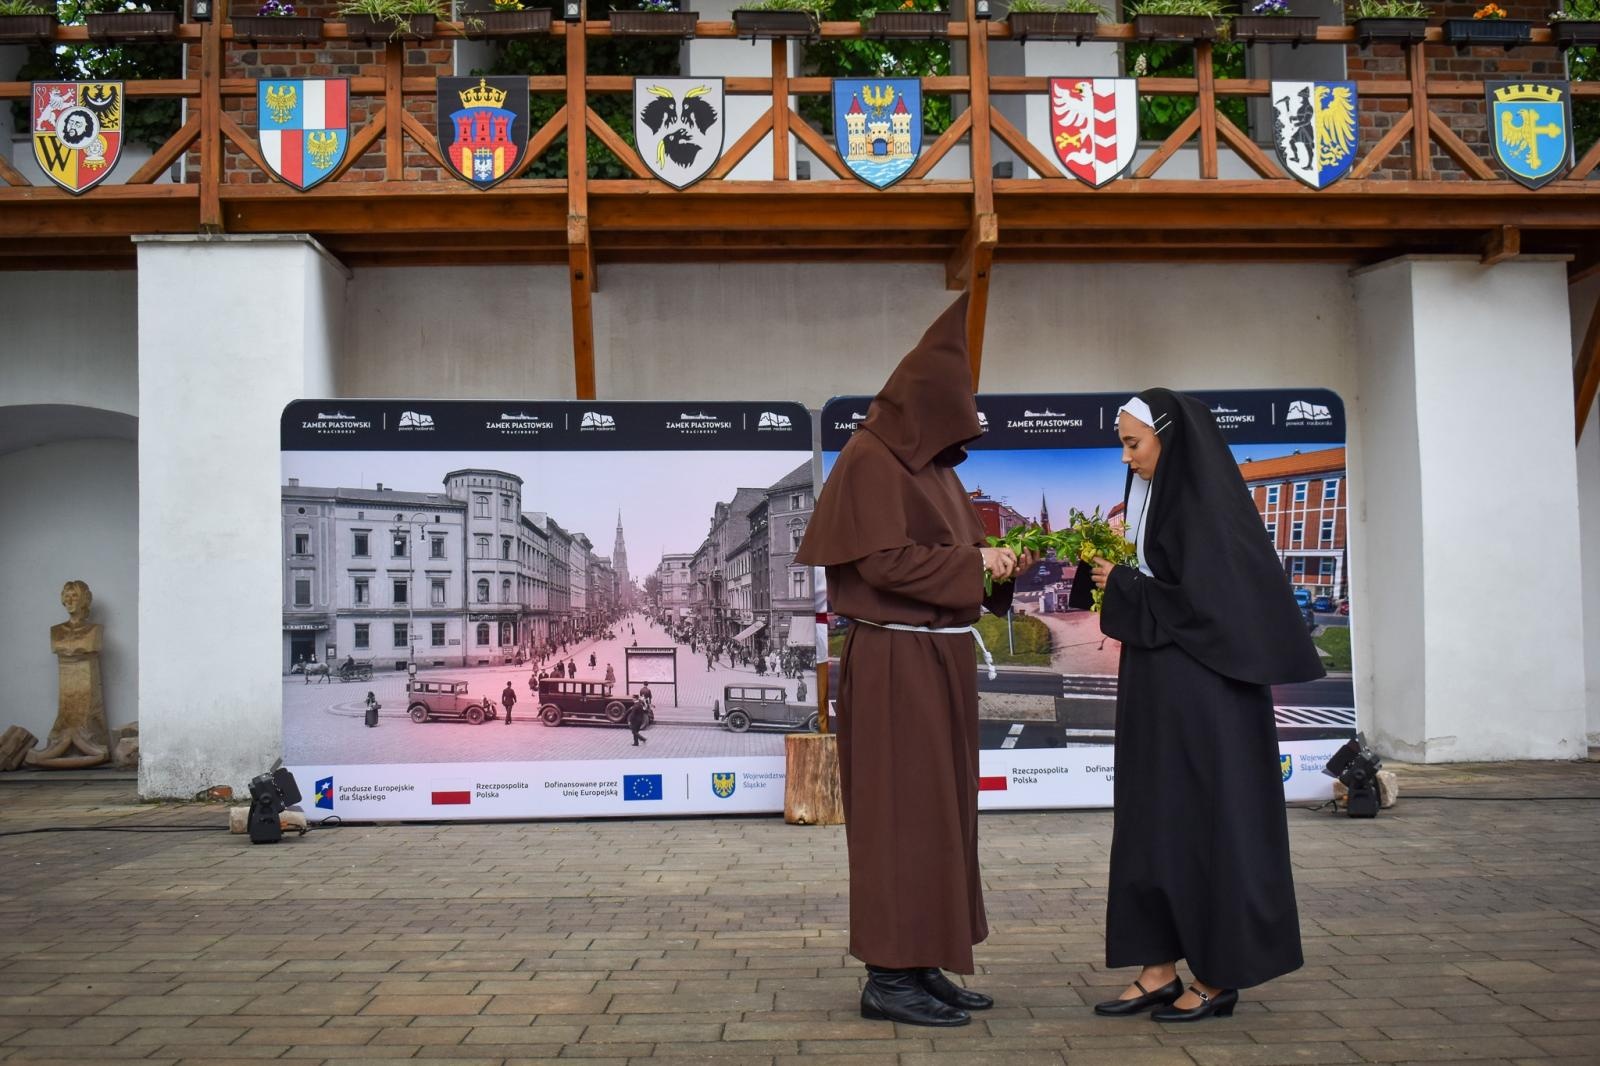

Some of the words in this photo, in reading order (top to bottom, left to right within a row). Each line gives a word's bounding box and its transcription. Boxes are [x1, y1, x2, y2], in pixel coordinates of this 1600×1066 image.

[1007, 420, 1034, 428] ZAMEK
[1036, 419, 1083, 427] PIASTOWSKI
[1215, 415, 1255, 423] ASTOWSKI
[302, 421, 327, 429] ZAMEK
[328, 421, 371, 429] PIASTOWSKI
[1012, 766, 1069, 776] Rzeczpospolita
[1085, 765, 1115, 773] Dofinan
[743, 772, 786, 781] Województw
[1012, 776, 1038, 784] Polska
[476, 782, 529, 792] Rzeczpospolita
[544, 779, 598, 788] Dofinansowane
[599, 780, 618, 789] przez
[339, 785, 372, 793] Fundusze
[374, 784, 415, 794] Europejskie
[562, 788, 579, 797] Unię
[580, 788, 618, 798] Europejską
[339, 793, 350, 801] dla
[351, 792, 386, 802] Śląskiego
[476, 790, 500, 798] Polska
